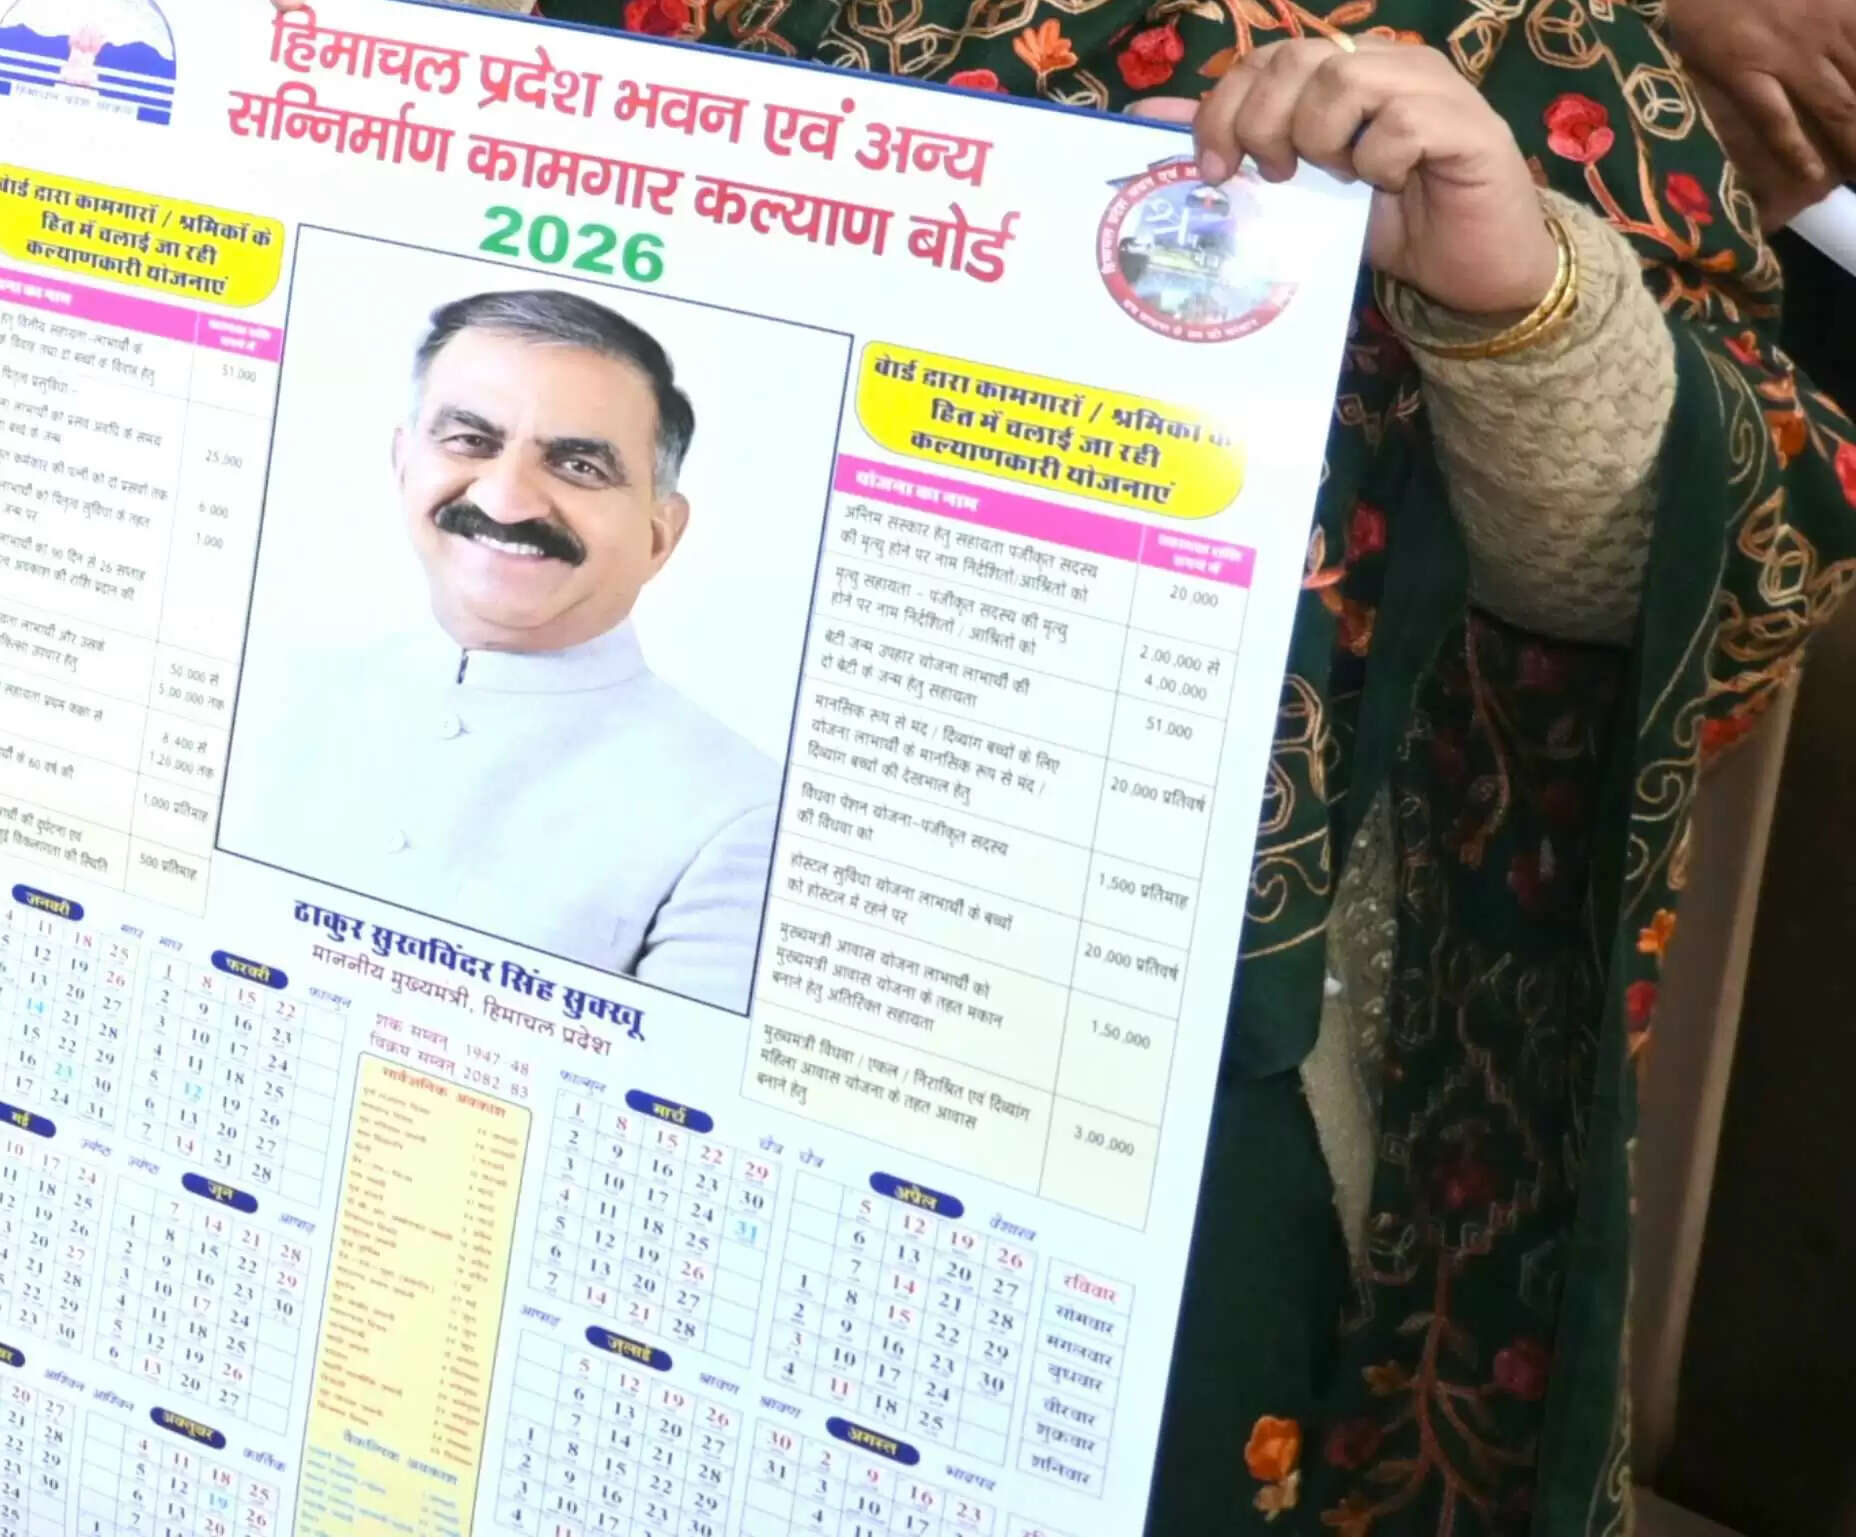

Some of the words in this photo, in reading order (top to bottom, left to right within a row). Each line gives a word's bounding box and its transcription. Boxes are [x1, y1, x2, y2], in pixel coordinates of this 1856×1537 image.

[271, 4, 470, 89] हिमाचल
[478, 45, 603, 118] प्रदेश
[614, 80, 750, 144] भवन
[764, 97, 856, 161] एवं
[855, 123, 994, 187] अन्य
[228, 81, 455, 172] सन्निर्माण
[468, 134, 685, 215] कामगार
[694, 175, 895, 256] कल्याण
[908, 202, 1020, 283] बोर्ड
[479, 206, 664, 283] 2026
[295, 901, 365, 942] ठाकुर
[372, 925, 494, 982] सुखविंदर
[501, 961, 556, 1001] सिंह
